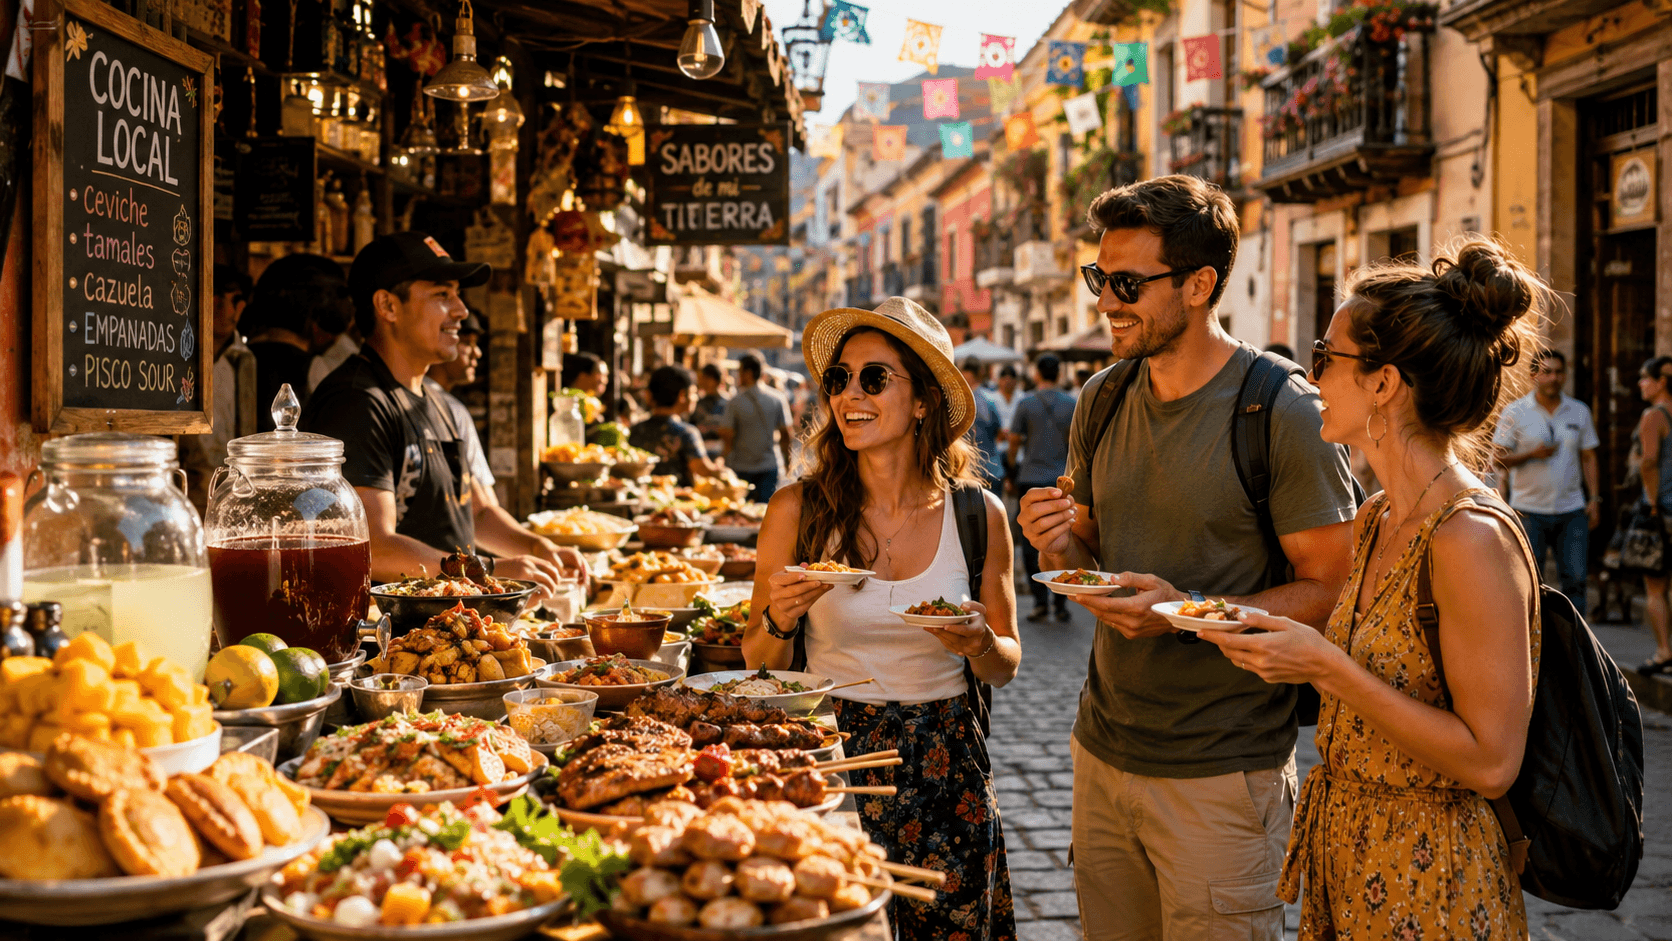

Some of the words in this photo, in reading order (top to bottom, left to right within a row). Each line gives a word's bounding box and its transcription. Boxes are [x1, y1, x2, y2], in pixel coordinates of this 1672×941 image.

[89, 51, 182, 135] COCINA
[97, 110, 179, 187] LOCAL
[660, 143, 775, 175] SABORES
[692, 177, 713, 197] de
[83, 222, 155, 269] tamales
[84, 311, 176, 354] EMPANADAS
[84, 353, 131, 389] PISCO
[138, 360, 176, 393] SOUR
